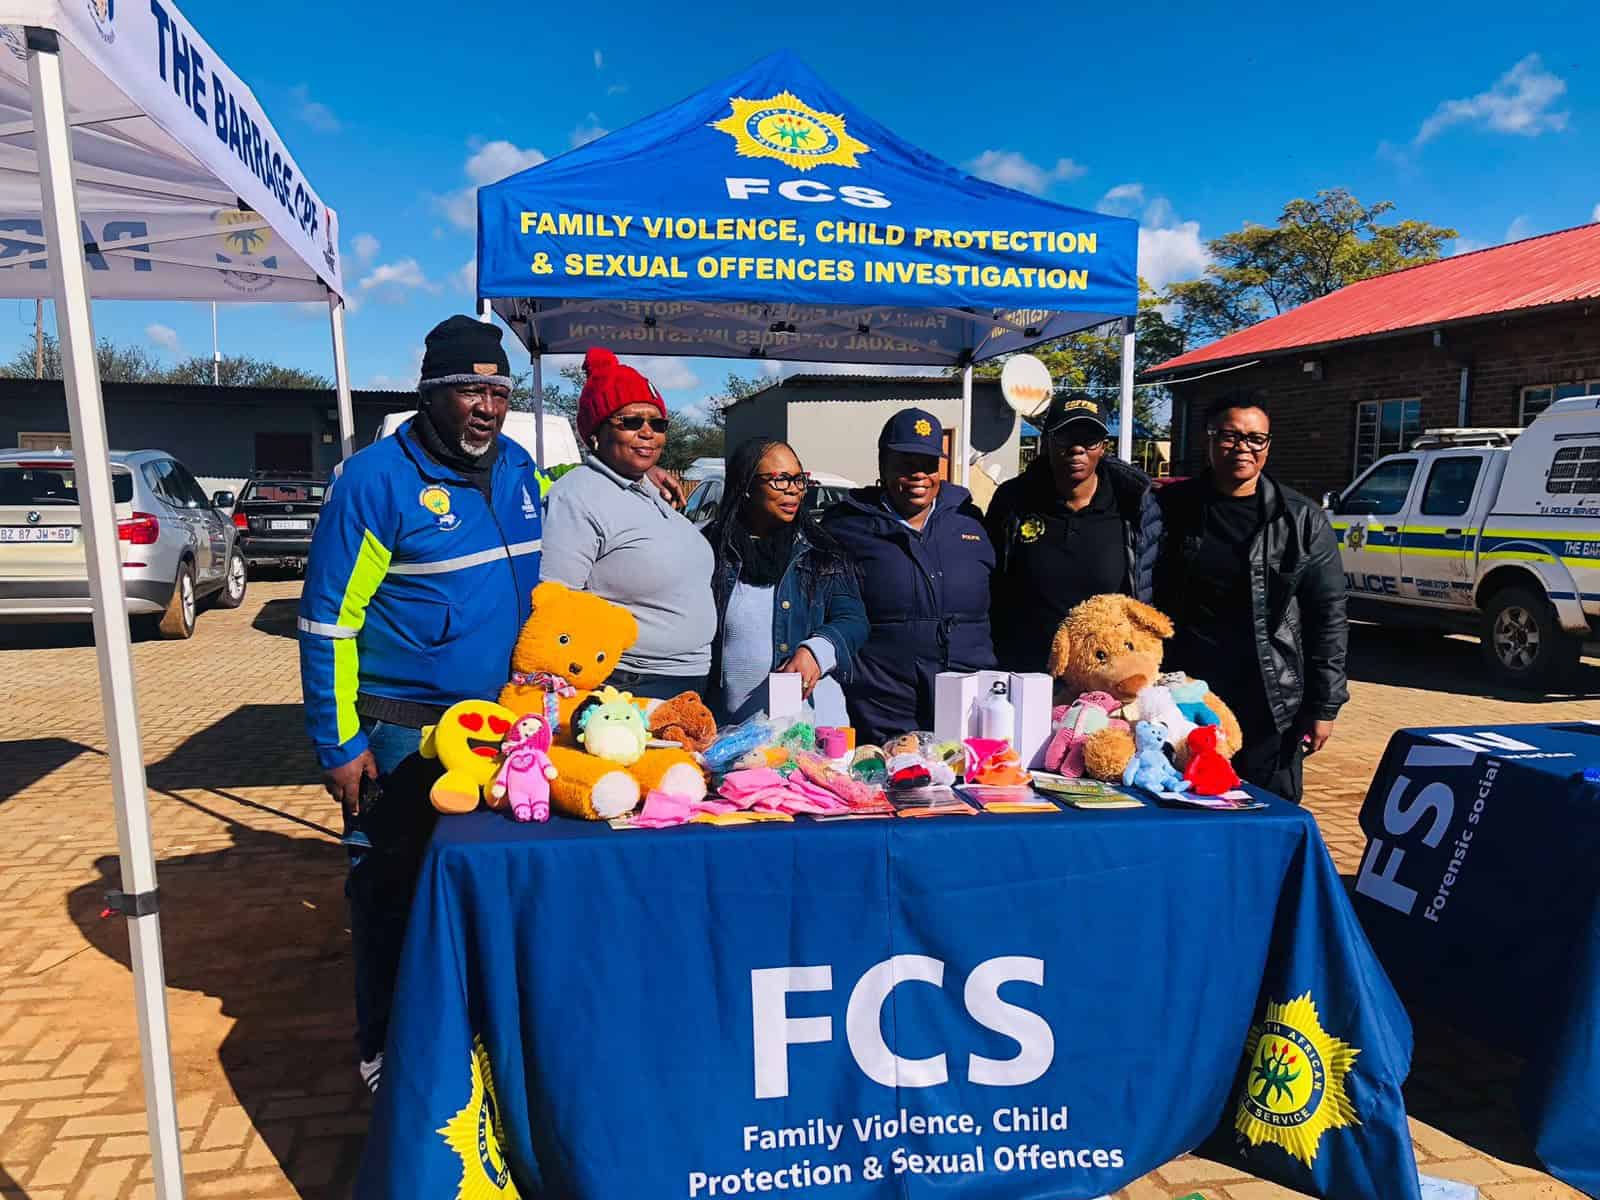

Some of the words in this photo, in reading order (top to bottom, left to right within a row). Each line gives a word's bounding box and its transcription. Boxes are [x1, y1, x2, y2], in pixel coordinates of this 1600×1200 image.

[150, 2, 208, 126] THE
[212, 72, 296, 219] BARRAGE
[295, 183, 319, 240] CPF
[726, 177, 891, 209] FCS
[520, 212, 631, 237] FAMILY
[644, 218, 806, 248] VIOLENCE,
[815, 221, 906, 246] CHILD
[914, 229, 1098, 254] PROTECTION
[531, 253, 552, 274] &
[565, 255, 686, 278] SEXUAL
[698, 257, 855, 282] OFFENCES
[865, 263, 1088, 290] INVESTIGATION
[19, 528, 31, 540] 87
[57, 528, 71, 540] GP
[1564, 541, 1583, 555] THE
[1423, 829, 1474, 923] Forensic
[1468, 759, 1502, 825] social
[751, 954, 1055, 1099] FCS
[1287, 1030, 1324, 1091] AFRICAN
[743, 1118, 844, 1152] Family
[852, 1108, 983, 1143] Violence,
[992, 1106, 1069, 1133] Child
[1254, 1109, 1311, 1125] SERVICE
[688, 1162, 852, 1199] Protection
[862, 1155, 885, 1182] &
[891, 1146, 984, 1177] Sexual
[993, 1143, 1125, 1171] Offences
